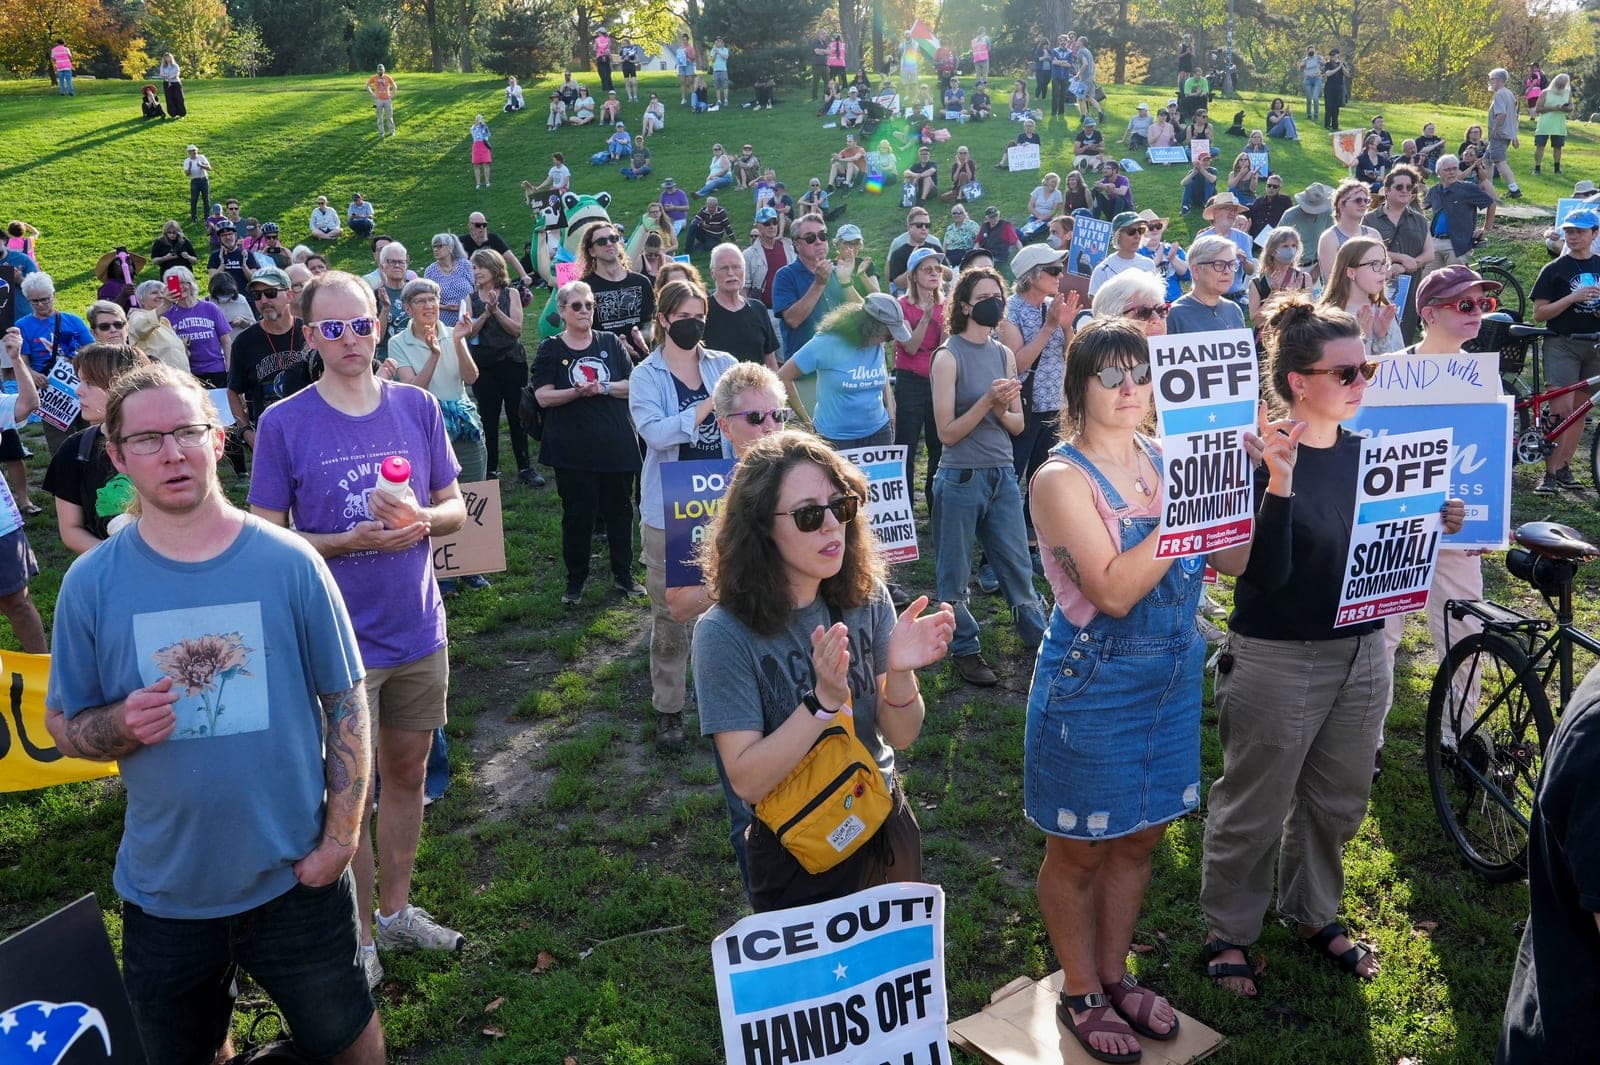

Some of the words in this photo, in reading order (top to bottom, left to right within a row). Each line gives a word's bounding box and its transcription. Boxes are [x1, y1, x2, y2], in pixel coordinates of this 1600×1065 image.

[1077, 218, 1109, 233] STAND
[1079, 228, 1104, 241] WITH
[179, 317, 215, 330] CATHERINE
[1156, 340, 1252, 366] HANDS
[54, 368, 80, 385] OF
[1160, 362, 1252, 403] OFF
[1447, 358, 1483, 387] with
[39, 388, 78, 417] SOMALI
[53, 387, 73, 403] THE
[1187, 430, 1238, 455] THE
[1366, 439, 1448, 465] HANDS
[862, 450, 904, 463] OUT!
[1169, 449, 1250, 500] SOMALI
[1363, 458, 1447, 497] OFF
[882, 480, 904, 501] OFF
[1166, 487, 1251, 528] COMMUNITY
[1376, 518, 1424, 539] THE
[1350, 531, 1438, 578] SOMALI
[1345, 565, 1431, 600] COMMUNITY
[726, 921, 819, 966] ICE
[826, 896, 934, 943] OUT!
[740, 994, 870, 1065] HANDS
[875, 968, 932, 1033] OFF
